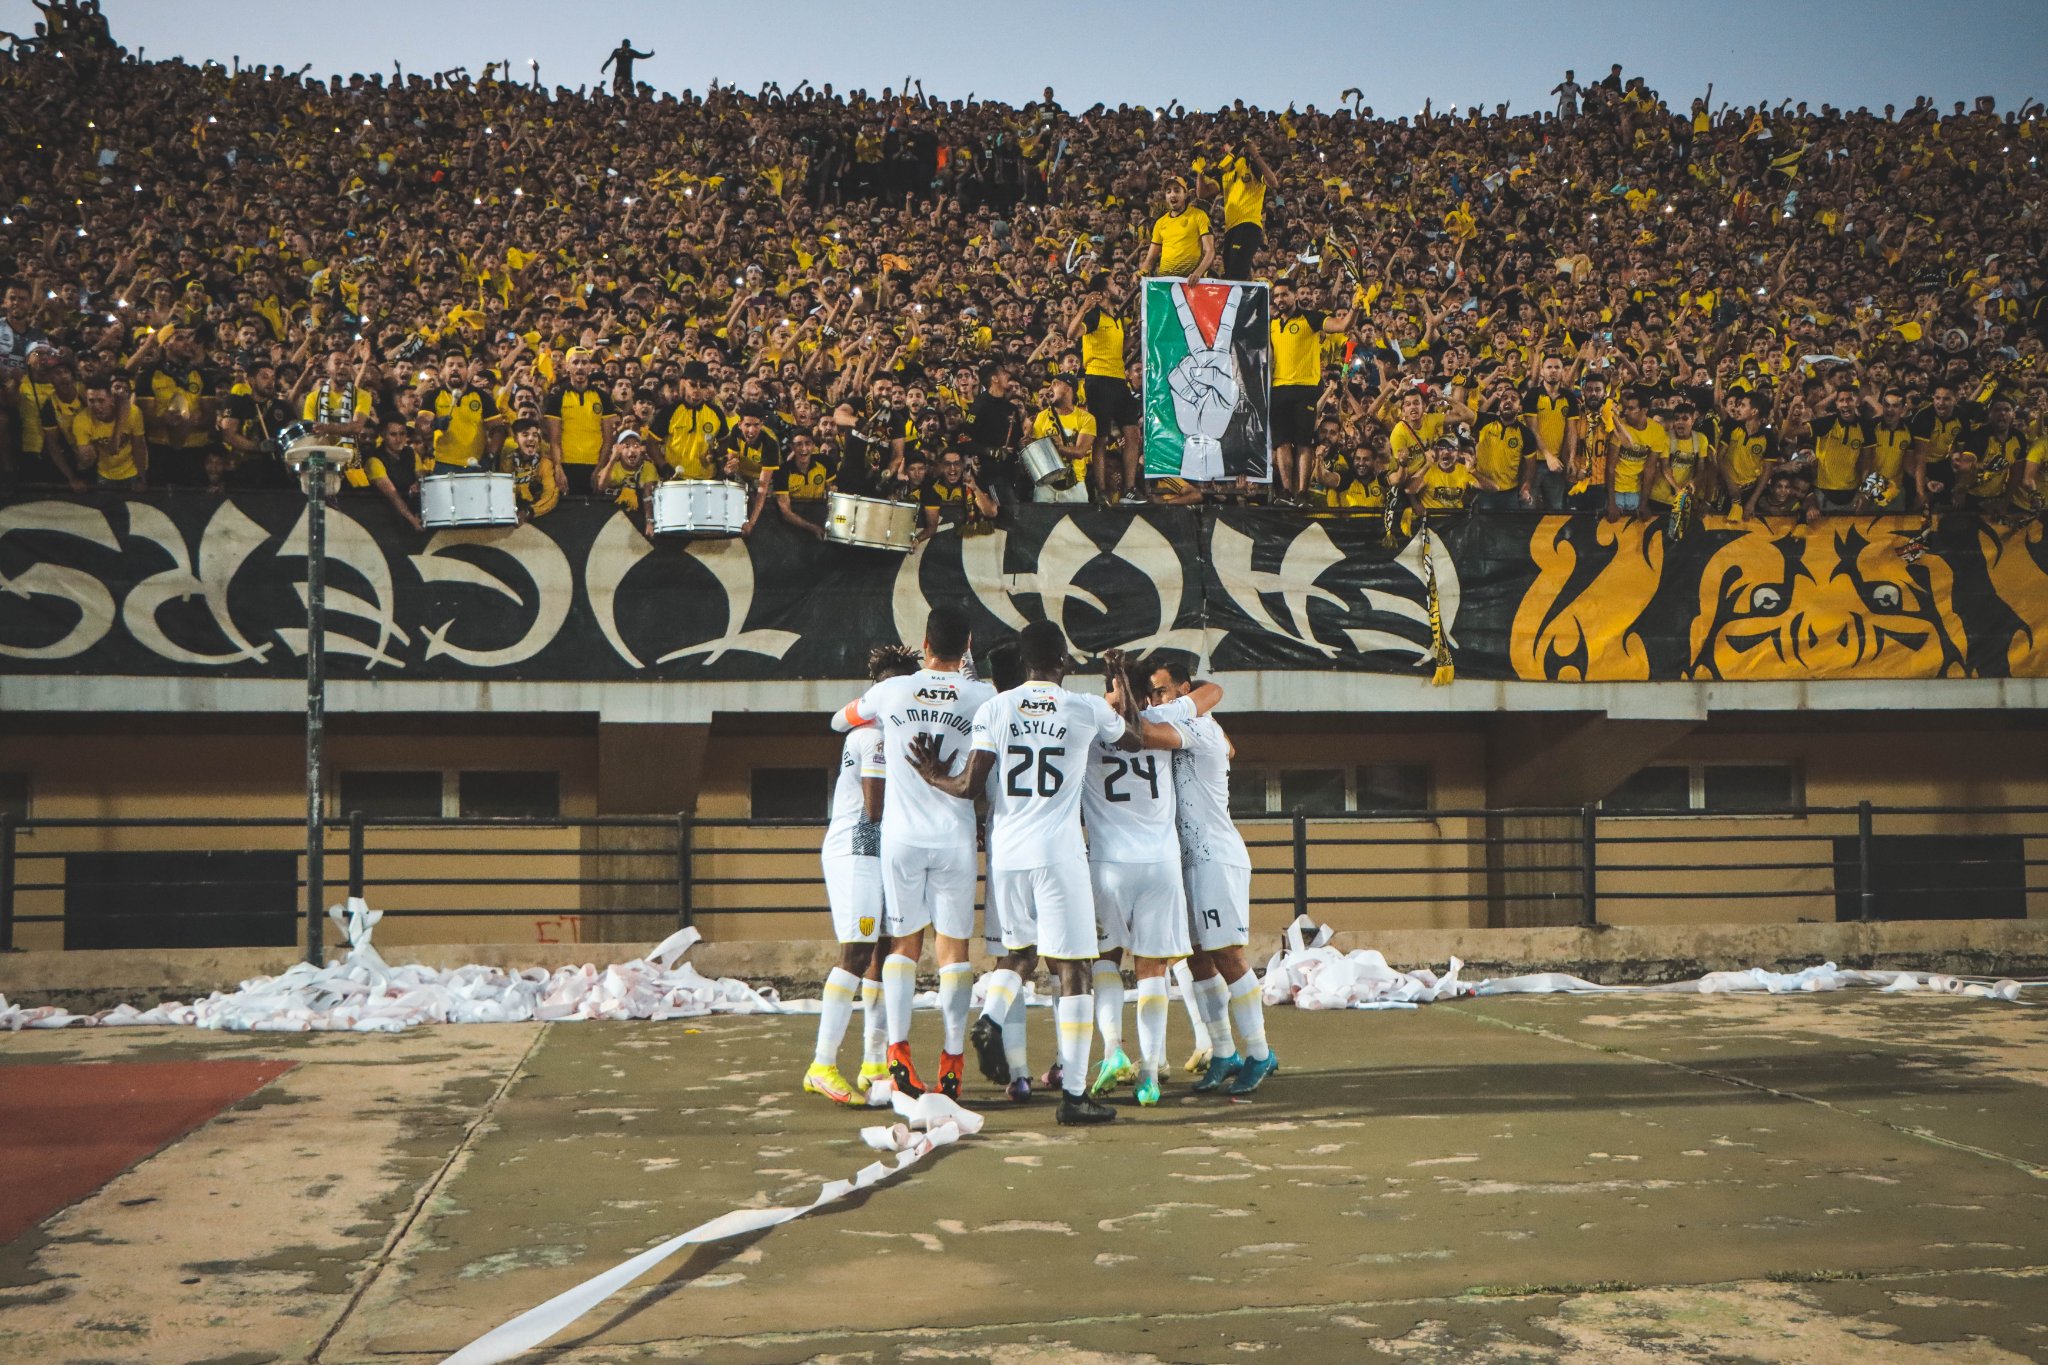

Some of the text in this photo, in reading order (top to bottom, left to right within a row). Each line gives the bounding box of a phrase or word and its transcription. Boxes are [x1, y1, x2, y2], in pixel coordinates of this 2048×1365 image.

[917, 687, 959, 701] ASTA
[1020, 698, 1058, 713] ASTA
[1010, 720, 1067, 740] B.SYLLA
[1007, 745, 1066, 798] 26
[1101, 755, 1160, 803] 24
[1202, 908, 1221, 930] 19
